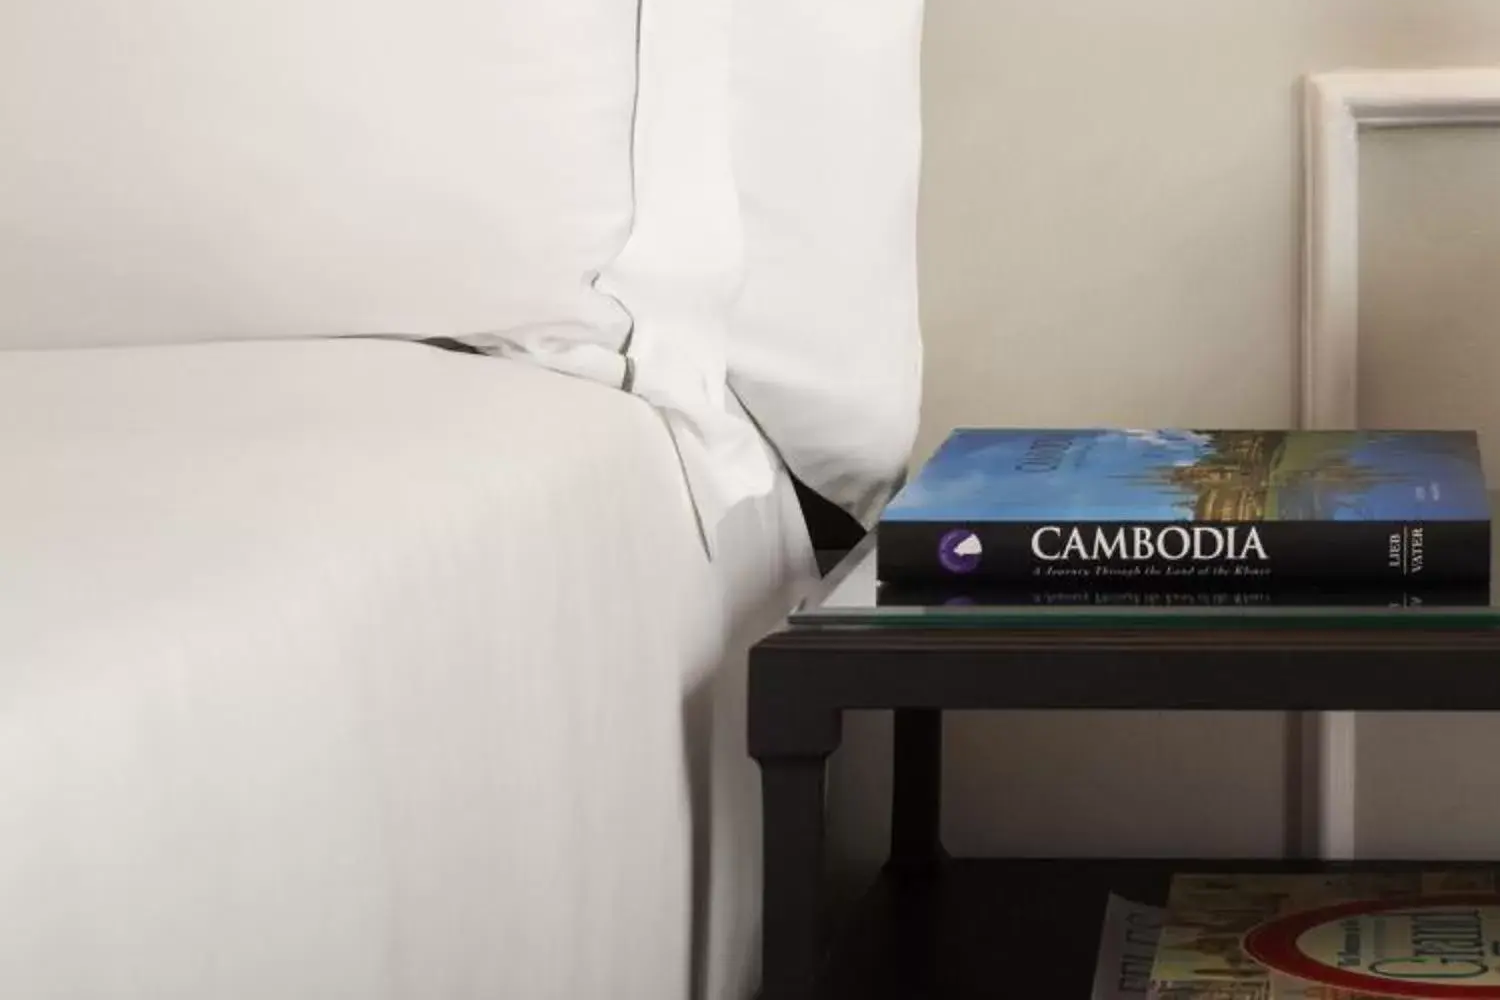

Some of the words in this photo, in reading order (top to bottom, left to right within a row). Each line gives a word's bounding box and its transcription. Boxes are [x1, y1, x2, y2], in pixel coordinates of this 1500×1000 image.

[1031, 526, 1269, 560] CAMBODIA
[1389, 533, 1401, 567] LIEB
[1411, 527, 1423, 573] VATER
[1368, 910, 1487, 978] Grand
